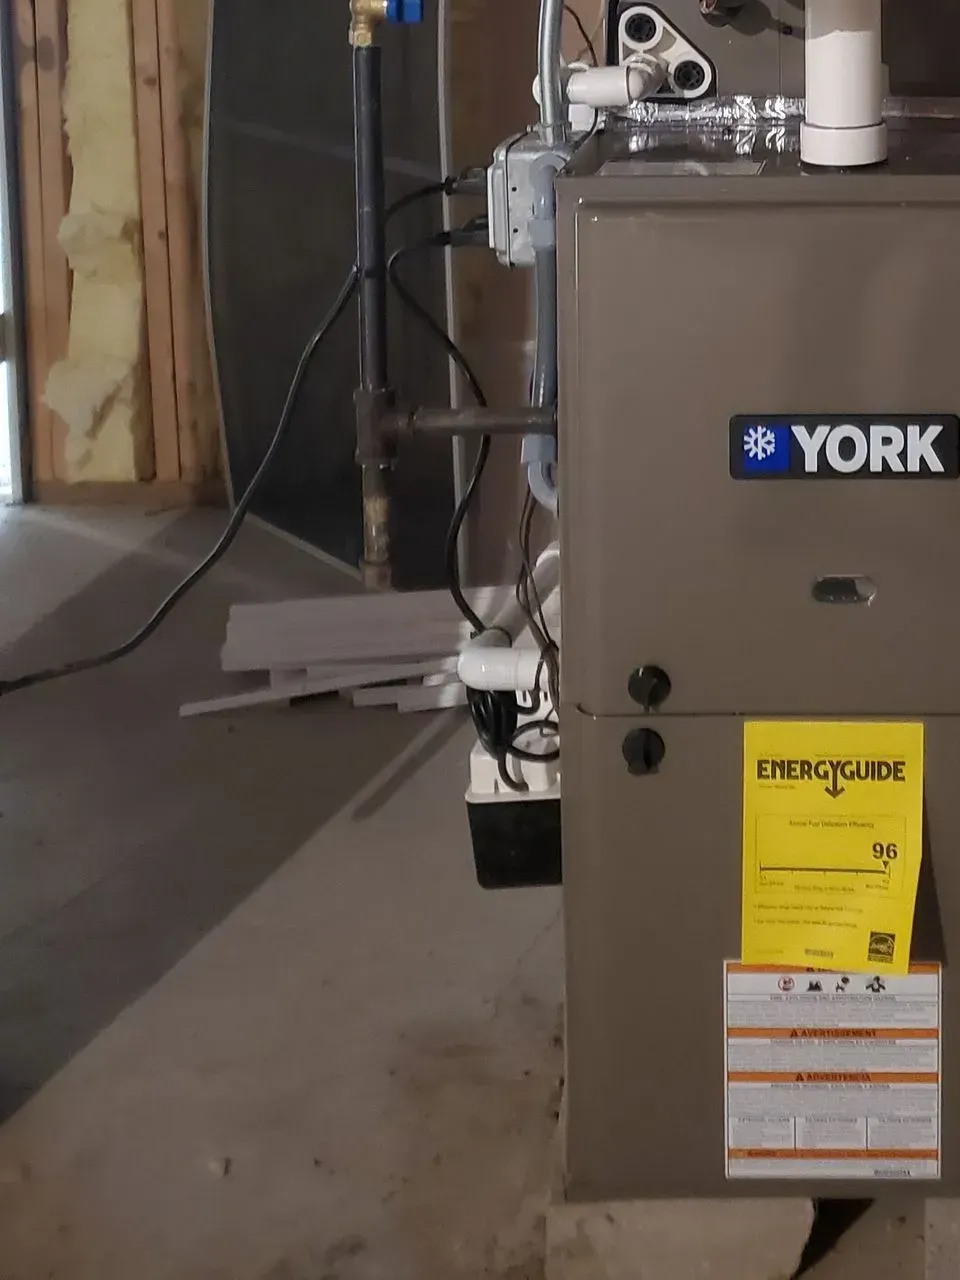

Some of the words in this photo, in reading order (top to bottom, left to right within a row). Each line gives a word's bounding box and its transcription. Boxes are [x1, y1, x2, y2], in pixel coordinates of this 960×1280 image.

[791, 424, 945, 474] YORK
[756, 758, 906, 792] ENERGYGUIDE
[871, 841, 899, 860] 96
